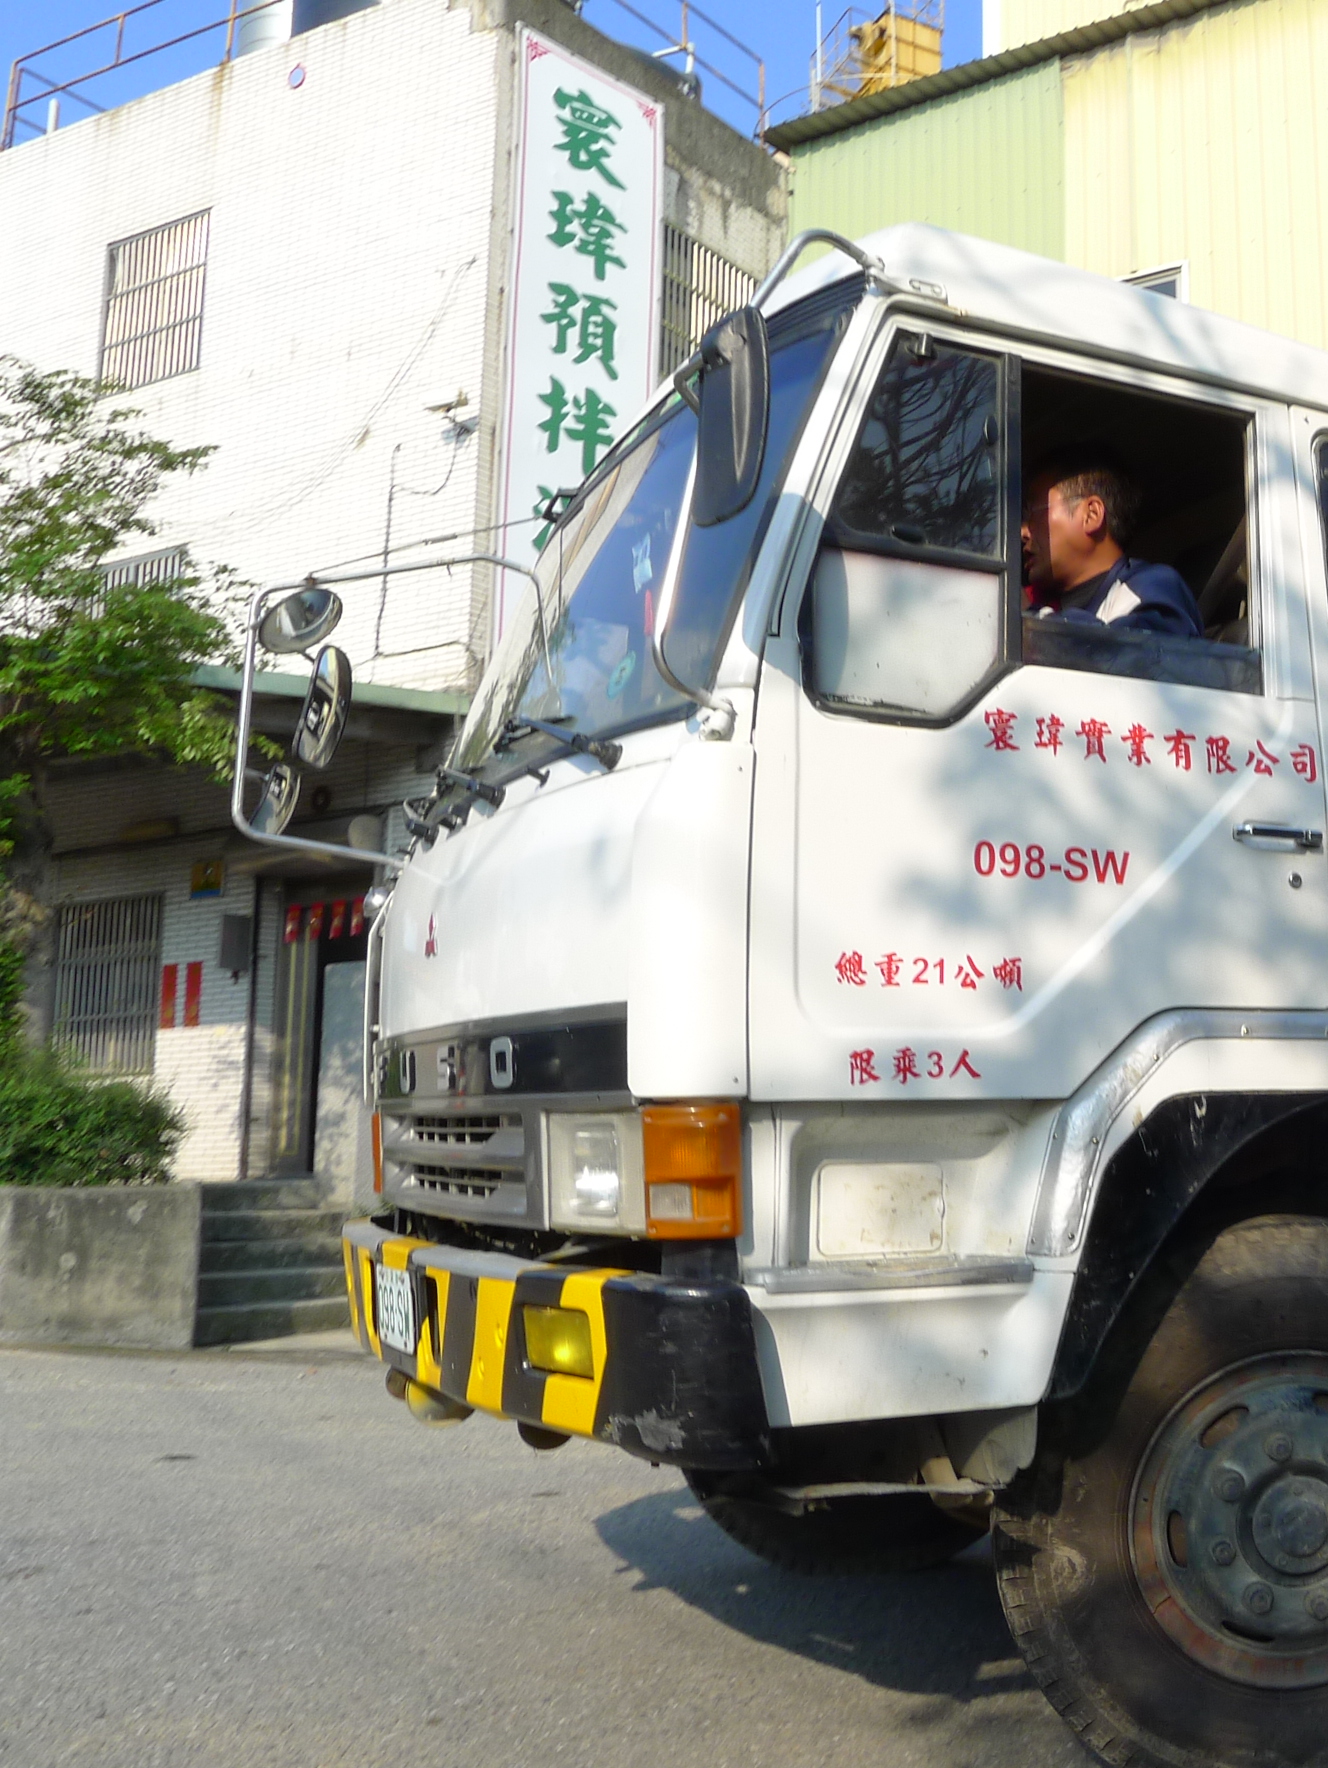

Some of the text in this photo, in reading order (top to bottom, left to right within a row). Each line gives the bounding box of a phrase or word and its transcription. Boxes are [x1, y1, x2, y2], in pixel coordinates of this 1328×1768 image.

[983, 707, 1319, 784] 寰瑋實業有限公司
[973, 840, 1130, 886] 098-SW
[834, 950, 1024, 992] 總重21公噸
[380, 1036, 515, 1095] USO
[849, 1046, 982, 1086] 限乘3人
